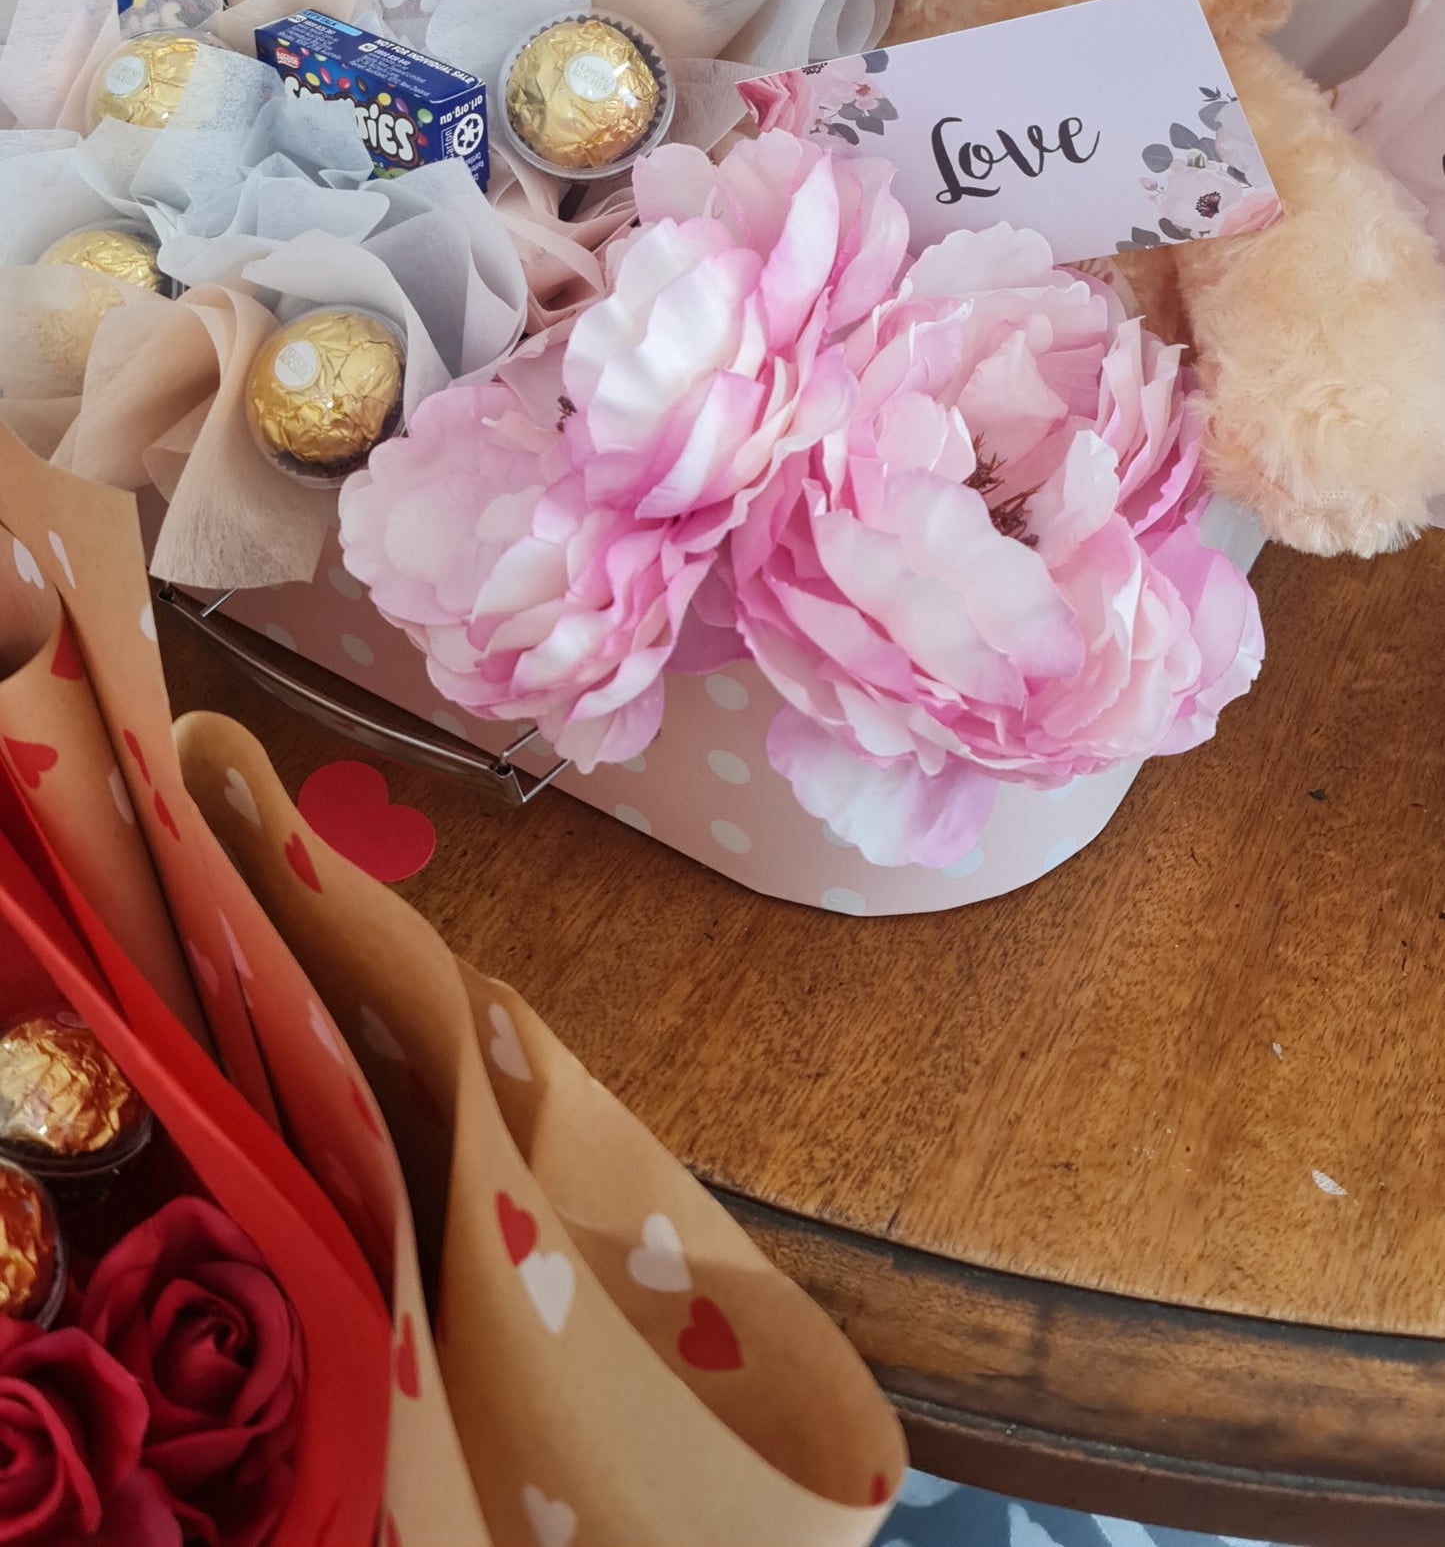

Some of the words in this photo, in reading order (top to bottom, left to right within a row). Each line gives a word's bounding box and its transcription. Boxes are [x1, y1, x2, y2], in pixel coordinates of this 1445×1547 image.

[374, 40, 394, 48] NOT
[390, 46, 410, 55] FOR
[404, 52, 454, 73] INDIVIDUAL
[448, 71, 476, 83] SALE
[439, 94, 483, 126] arl.org.au
[931, 117, 1101, 204] Love
